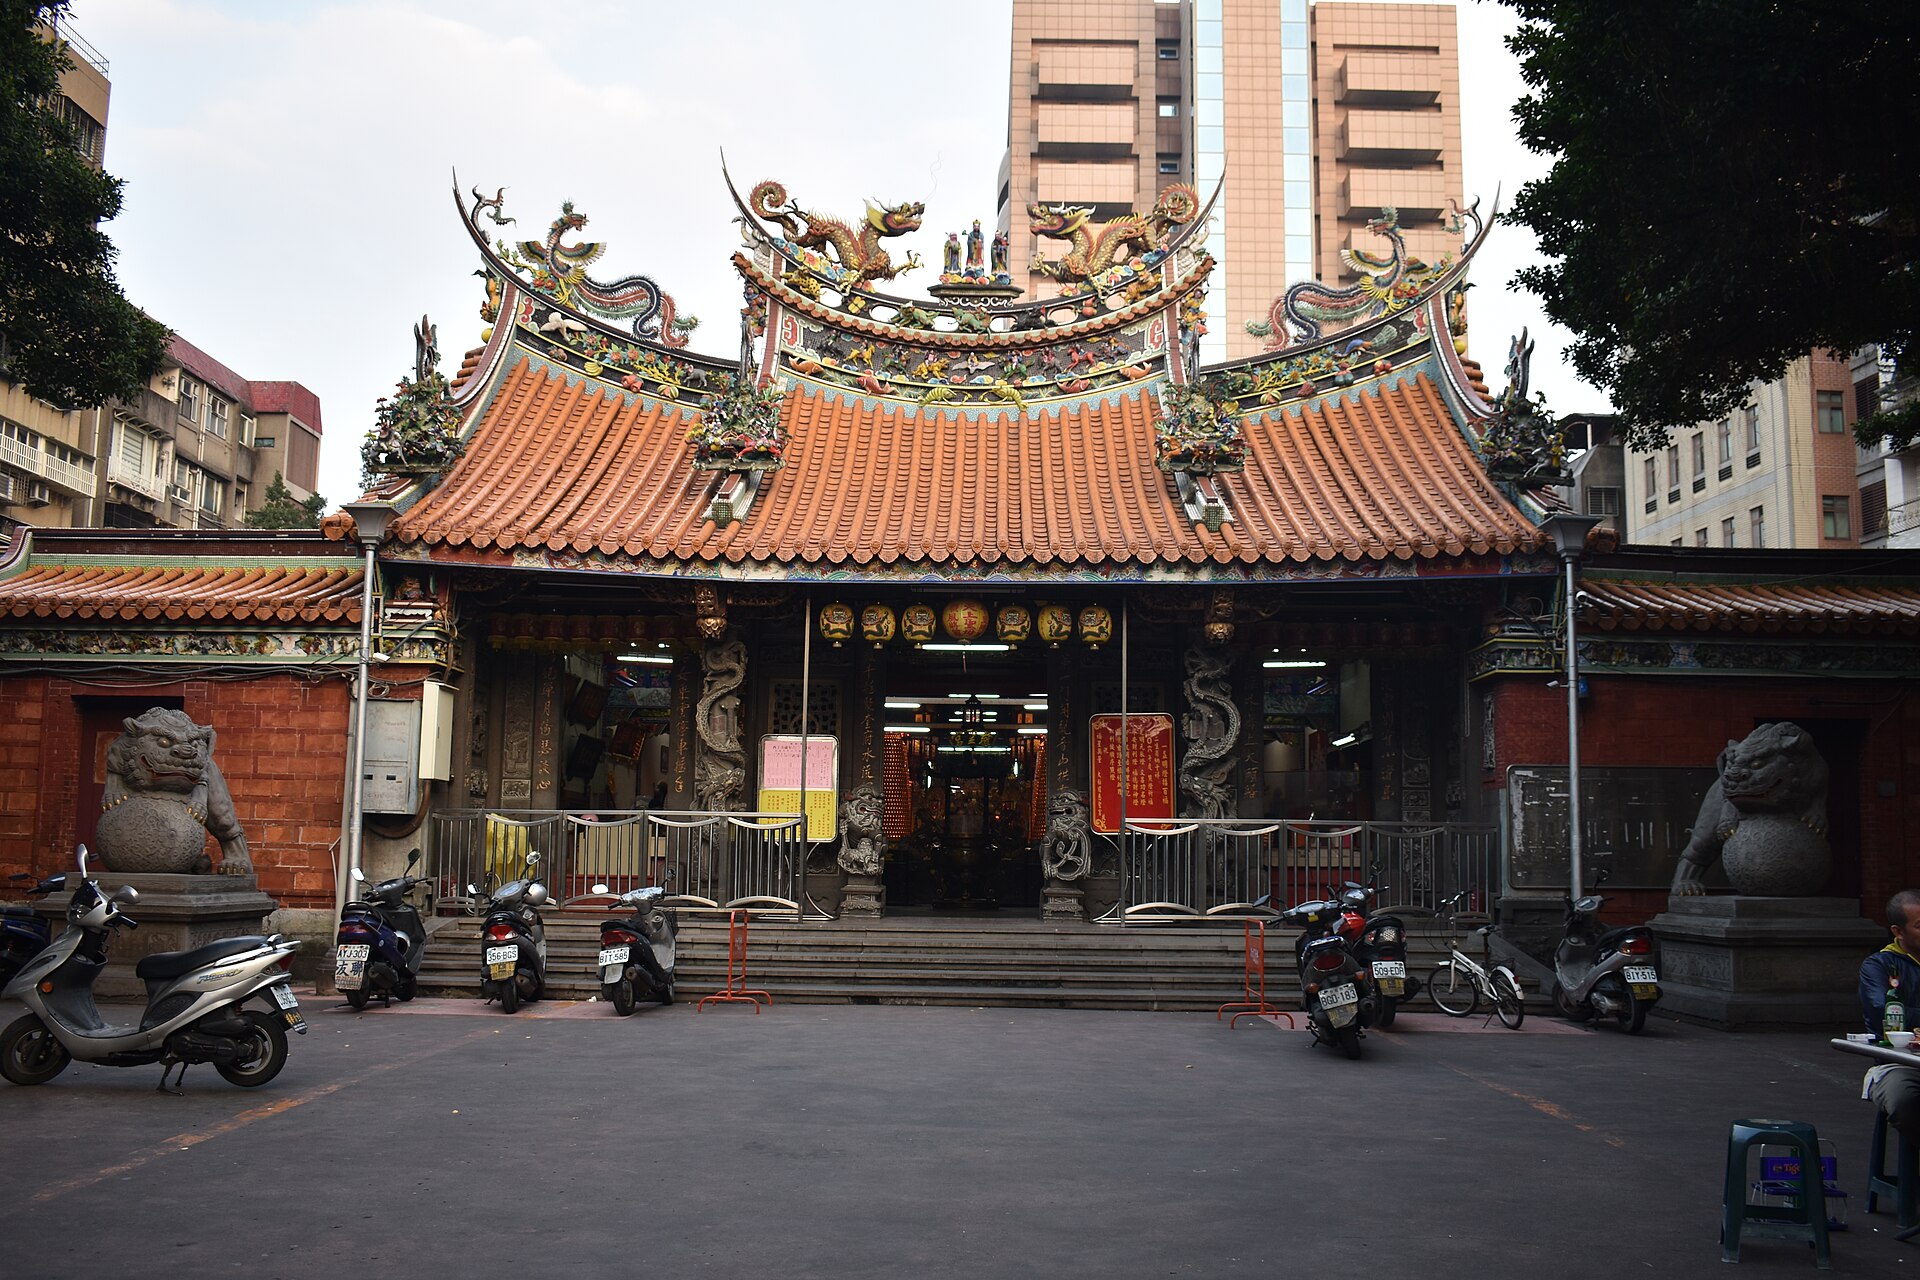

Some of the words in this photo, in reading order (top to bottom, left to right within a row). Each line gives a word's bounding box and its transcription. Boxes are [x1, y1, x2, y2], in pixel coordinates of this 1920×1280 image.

[337, 949, 368, 959] AYJ-303
[488, 950, 517, 962] 356-BGS
[1625, 971, 1656, 980] BIY-515
